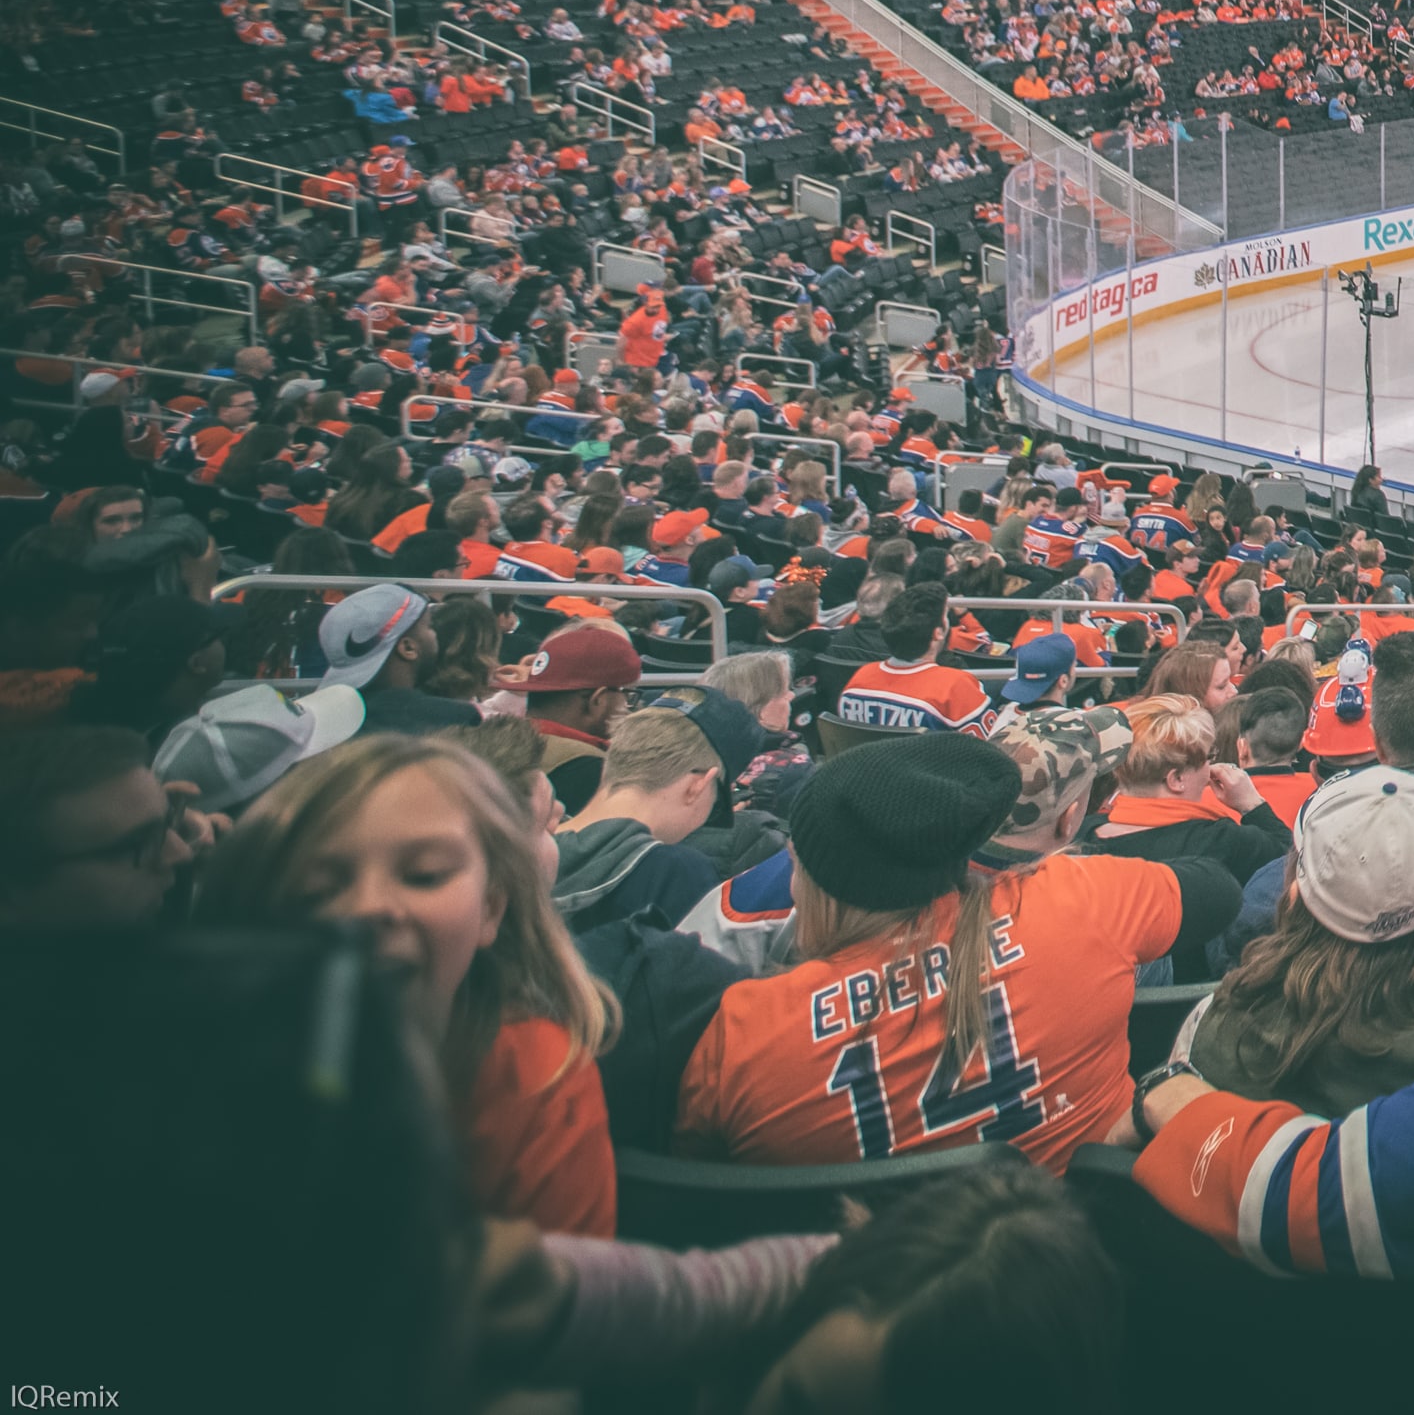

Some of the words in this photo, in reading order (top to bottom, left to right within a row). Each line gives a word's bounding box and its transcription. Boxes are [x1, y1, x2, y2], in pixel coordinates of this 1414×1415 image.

[1216, 241, 1311, 283] CANADIAN
[1244, 237, 1282, 253] MOLSON
[839, 697, 925, 728] GRETZKY
[811, 914, 1027, 1043] EBERE
[827, 982, 1046, 1160] 14
